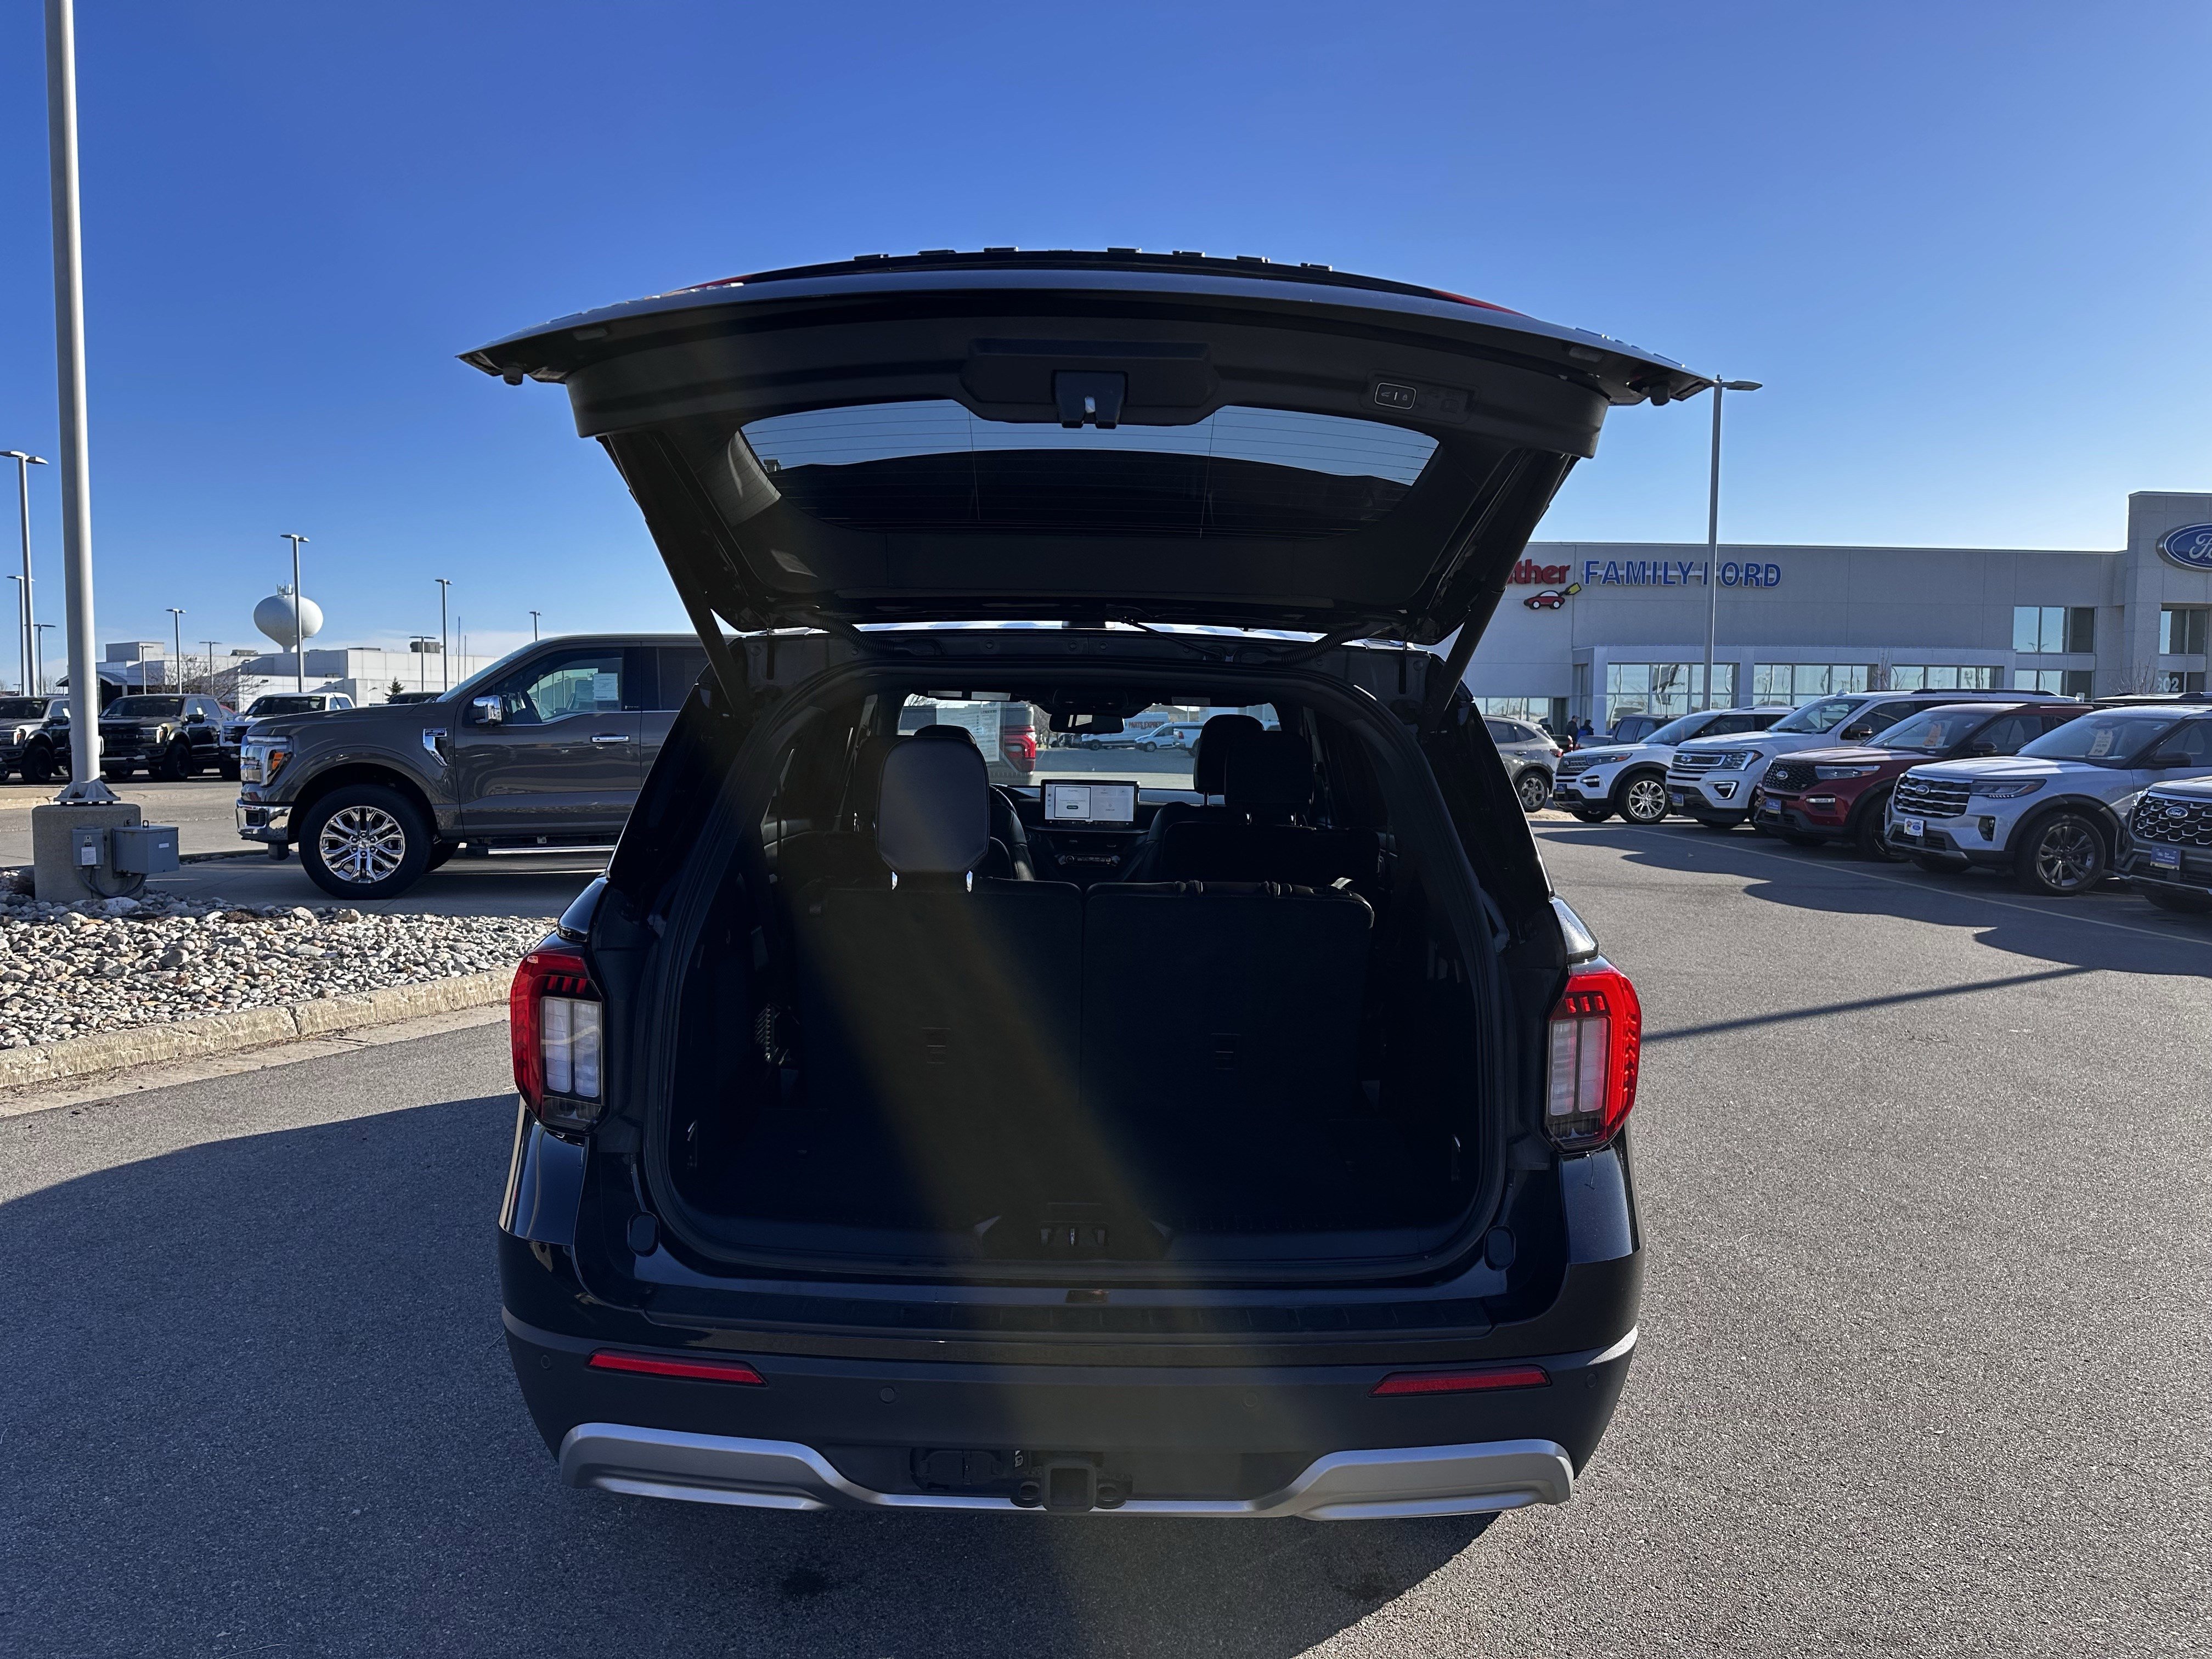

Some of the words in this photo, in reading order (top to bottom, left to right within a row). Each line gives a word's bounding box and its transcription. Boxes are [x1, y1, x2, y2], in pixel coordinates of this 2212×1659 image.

[1508, 559, 1571, 584] ther
[1584, 560, 1694, 585] FAMILY
[1703, 561, 1781, 587] ORD
